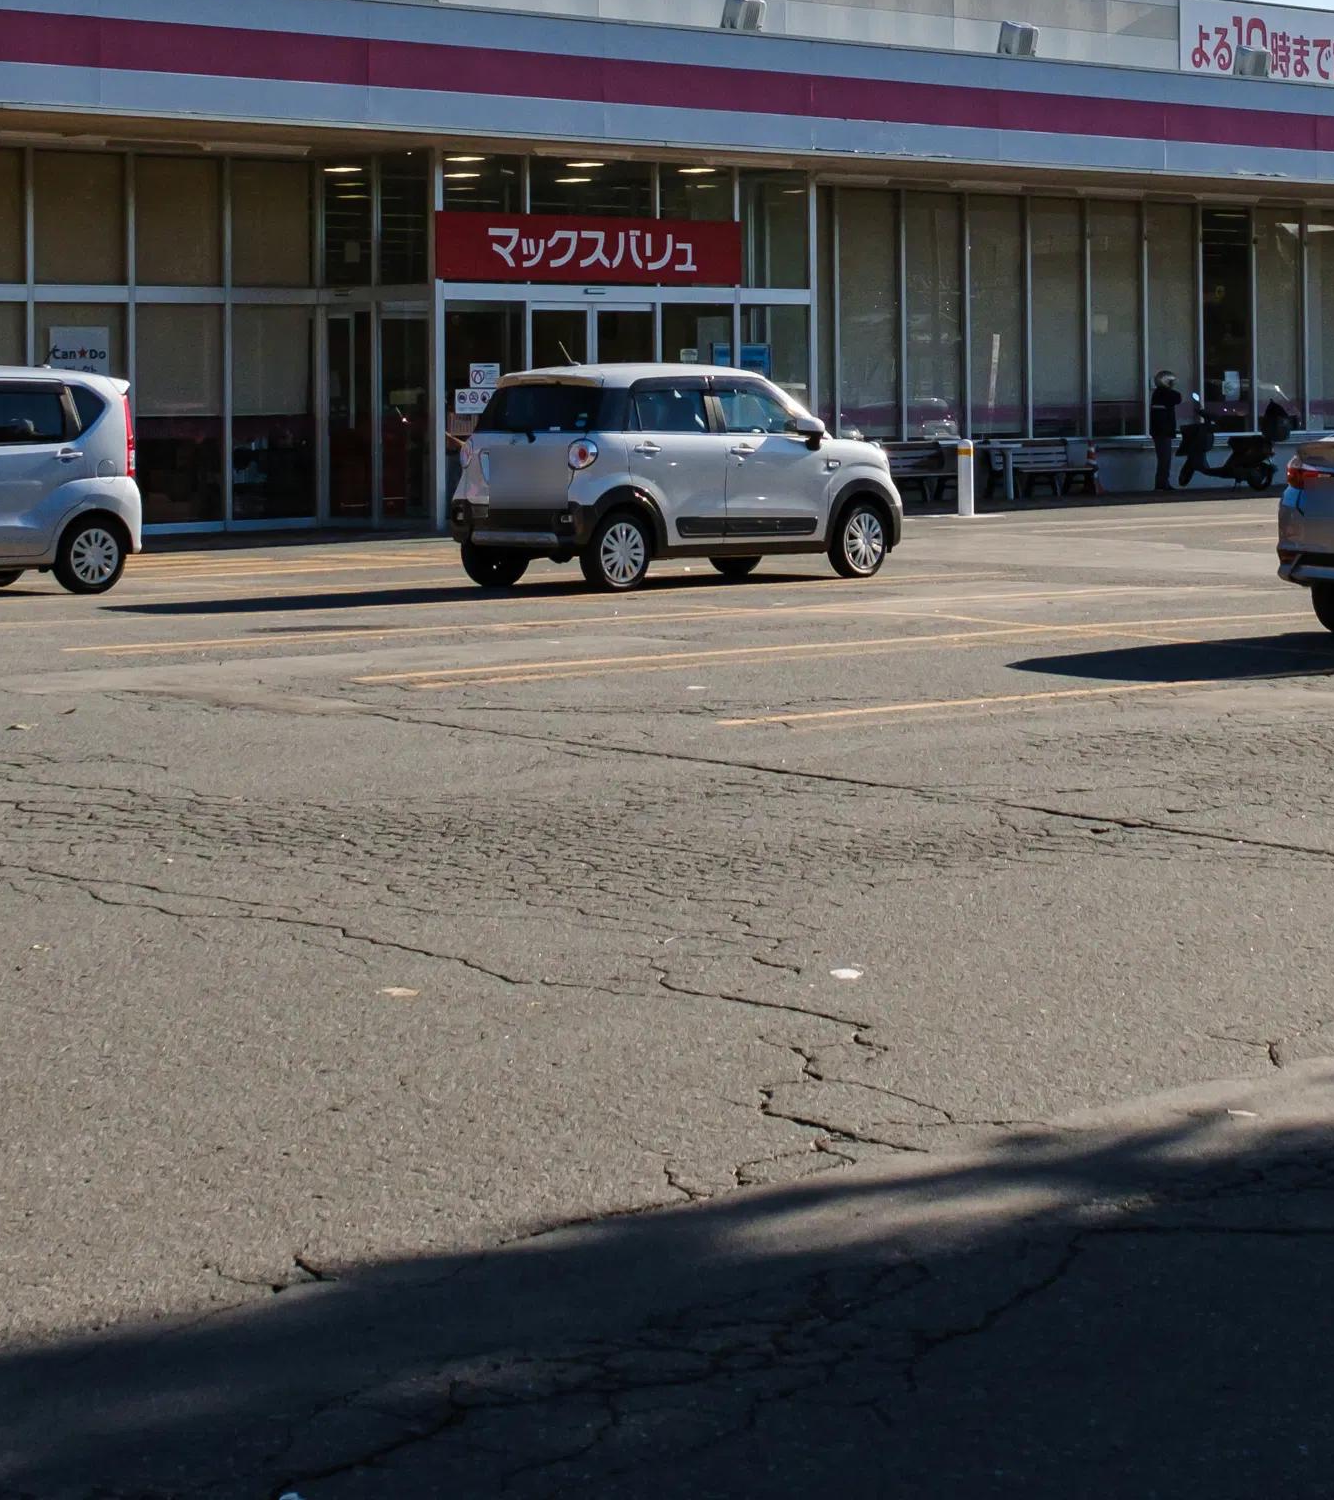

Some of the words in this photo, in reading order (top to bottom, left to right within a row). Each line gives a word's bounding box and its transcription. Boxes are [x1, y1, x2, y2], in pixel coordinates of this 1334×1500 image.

[488, 227, 697, 272] マックスバリュ
[52, 348, 76, 359] Can
[89, 348, 106, 359] Do
